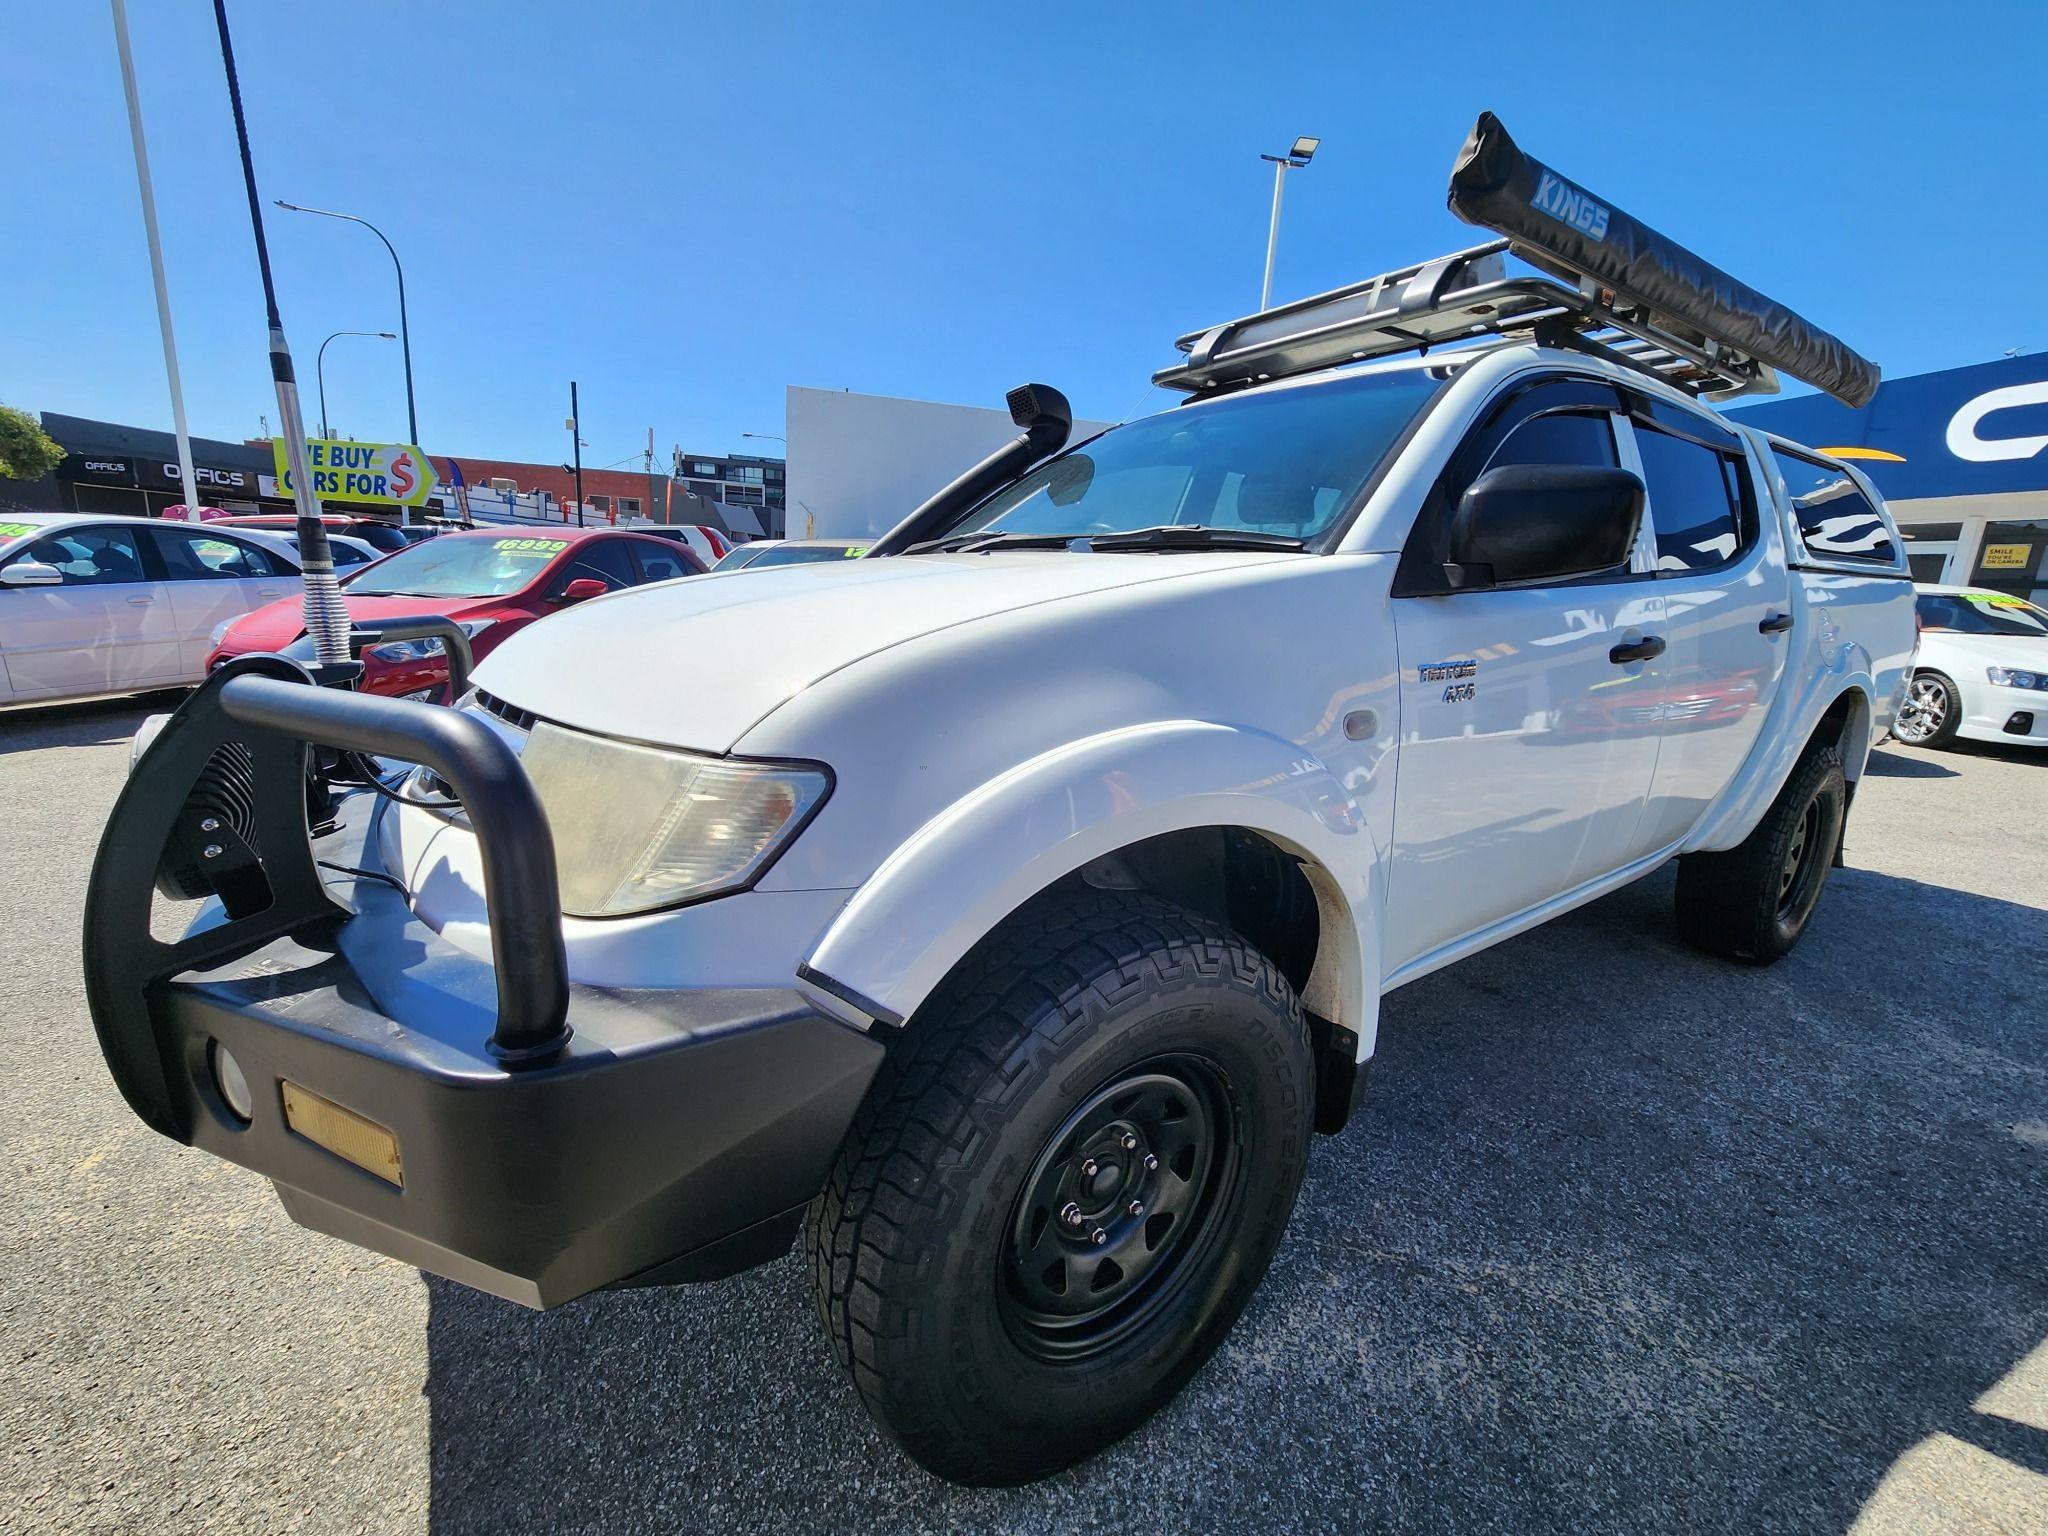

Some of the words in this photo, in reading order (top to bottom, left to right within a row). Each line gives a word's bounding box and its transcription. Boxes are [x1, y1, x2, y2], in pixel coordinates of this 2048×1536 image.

[1535, 173, 1610, 239] KINGS
[330, 446, 375, 469] BUY
[163, 463, 244, 486] OFICS
[284, 470, 339, 493] CRS
[346, 473, 387, 496] FOR
[493, 539, 568, 552] 16999
